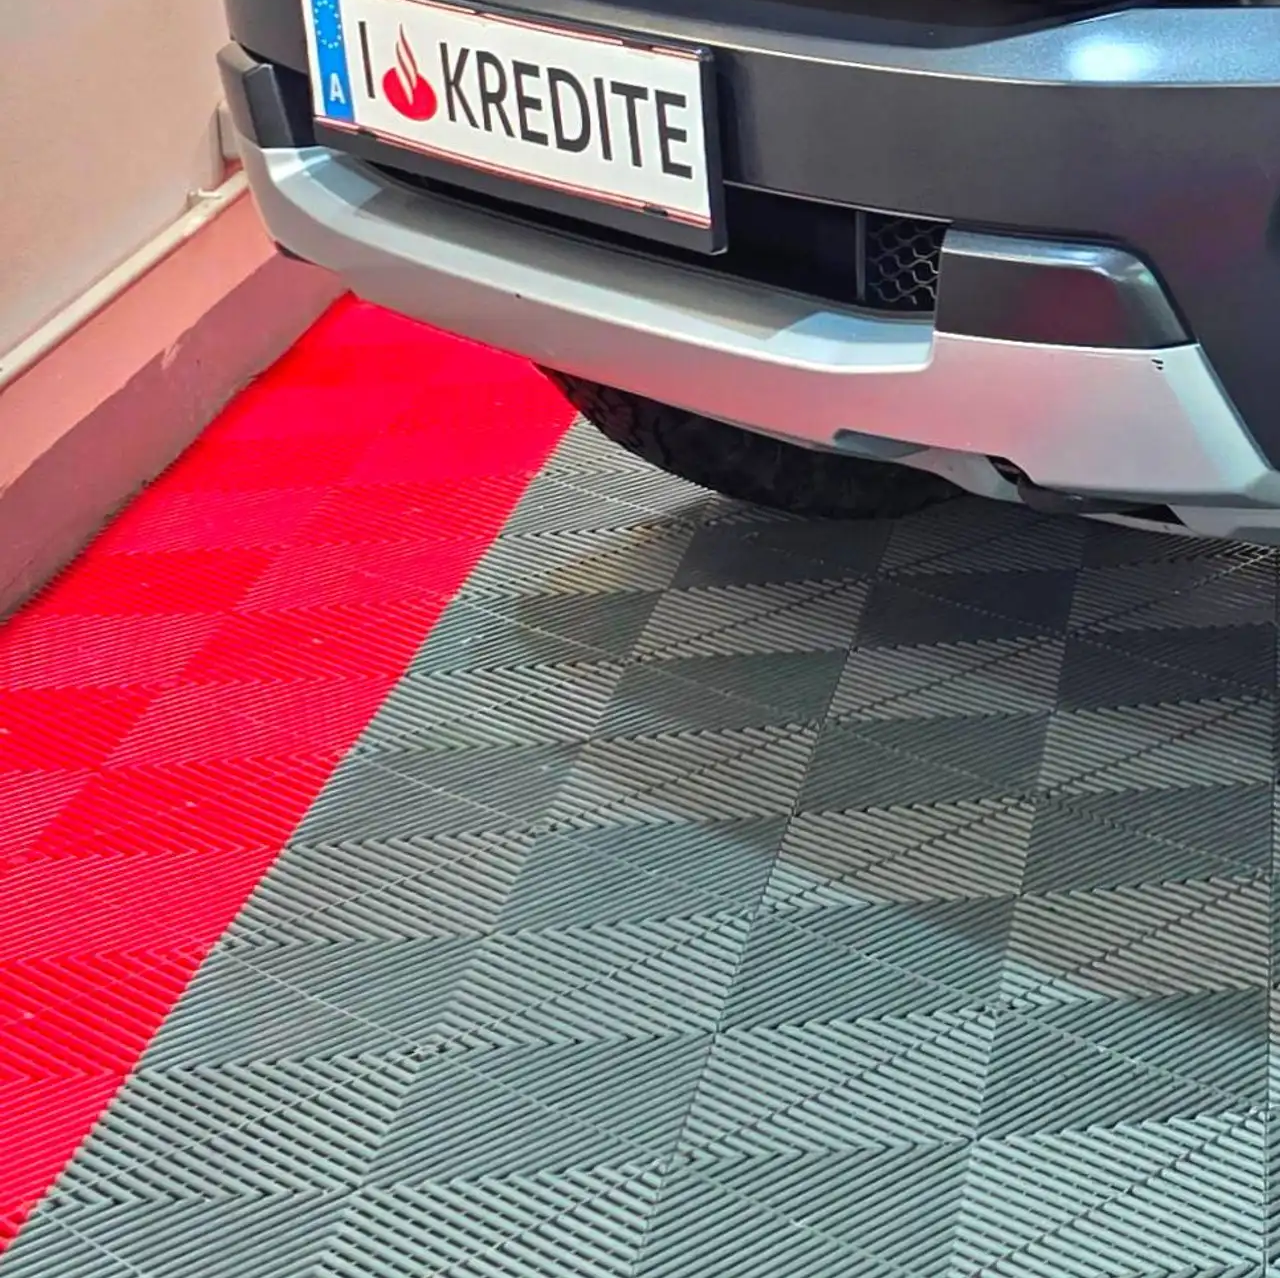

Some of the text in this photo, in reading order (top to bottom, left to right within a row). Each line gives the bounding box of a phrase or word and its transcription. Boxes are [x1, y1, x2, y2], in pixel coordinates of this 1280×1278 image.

[328, 72, 346, 105] A
[358, 21, 693, 180] I KREDITE
